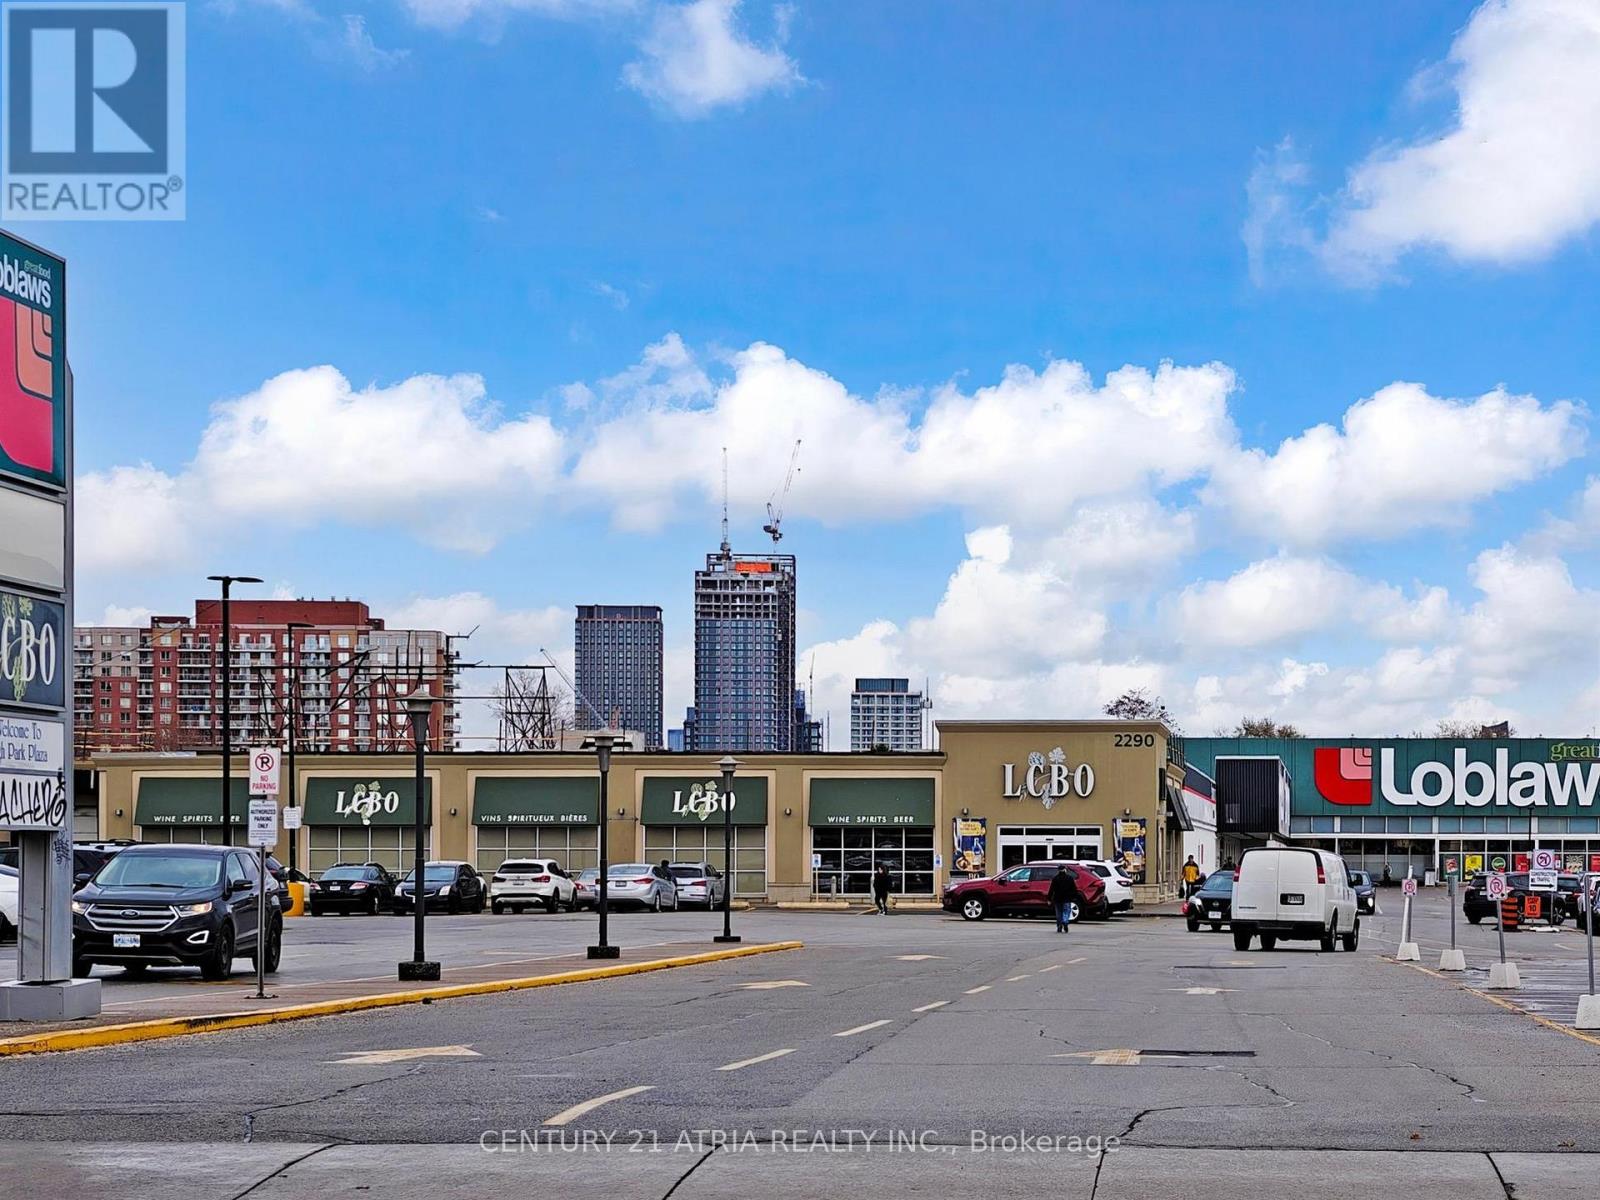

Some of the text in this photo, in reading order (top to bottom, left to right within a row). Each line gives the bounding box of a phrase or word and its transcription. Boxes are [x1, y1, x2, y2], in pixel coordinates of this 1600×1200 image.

[32, 722, 42, 740] To
[1114, 734, 1154, 747] 2290
[8, 743, 26, 761] Park
[28, 744, 48, 762] Plaza
[1551, 742, 1600, 762] great
[1002, 763, 1095, 798] LCBO
[335, 791, 400, 814] LCBO
[672, 791, 736, 813] LCBO
[560, 814, 588, 822] BIÈRES
